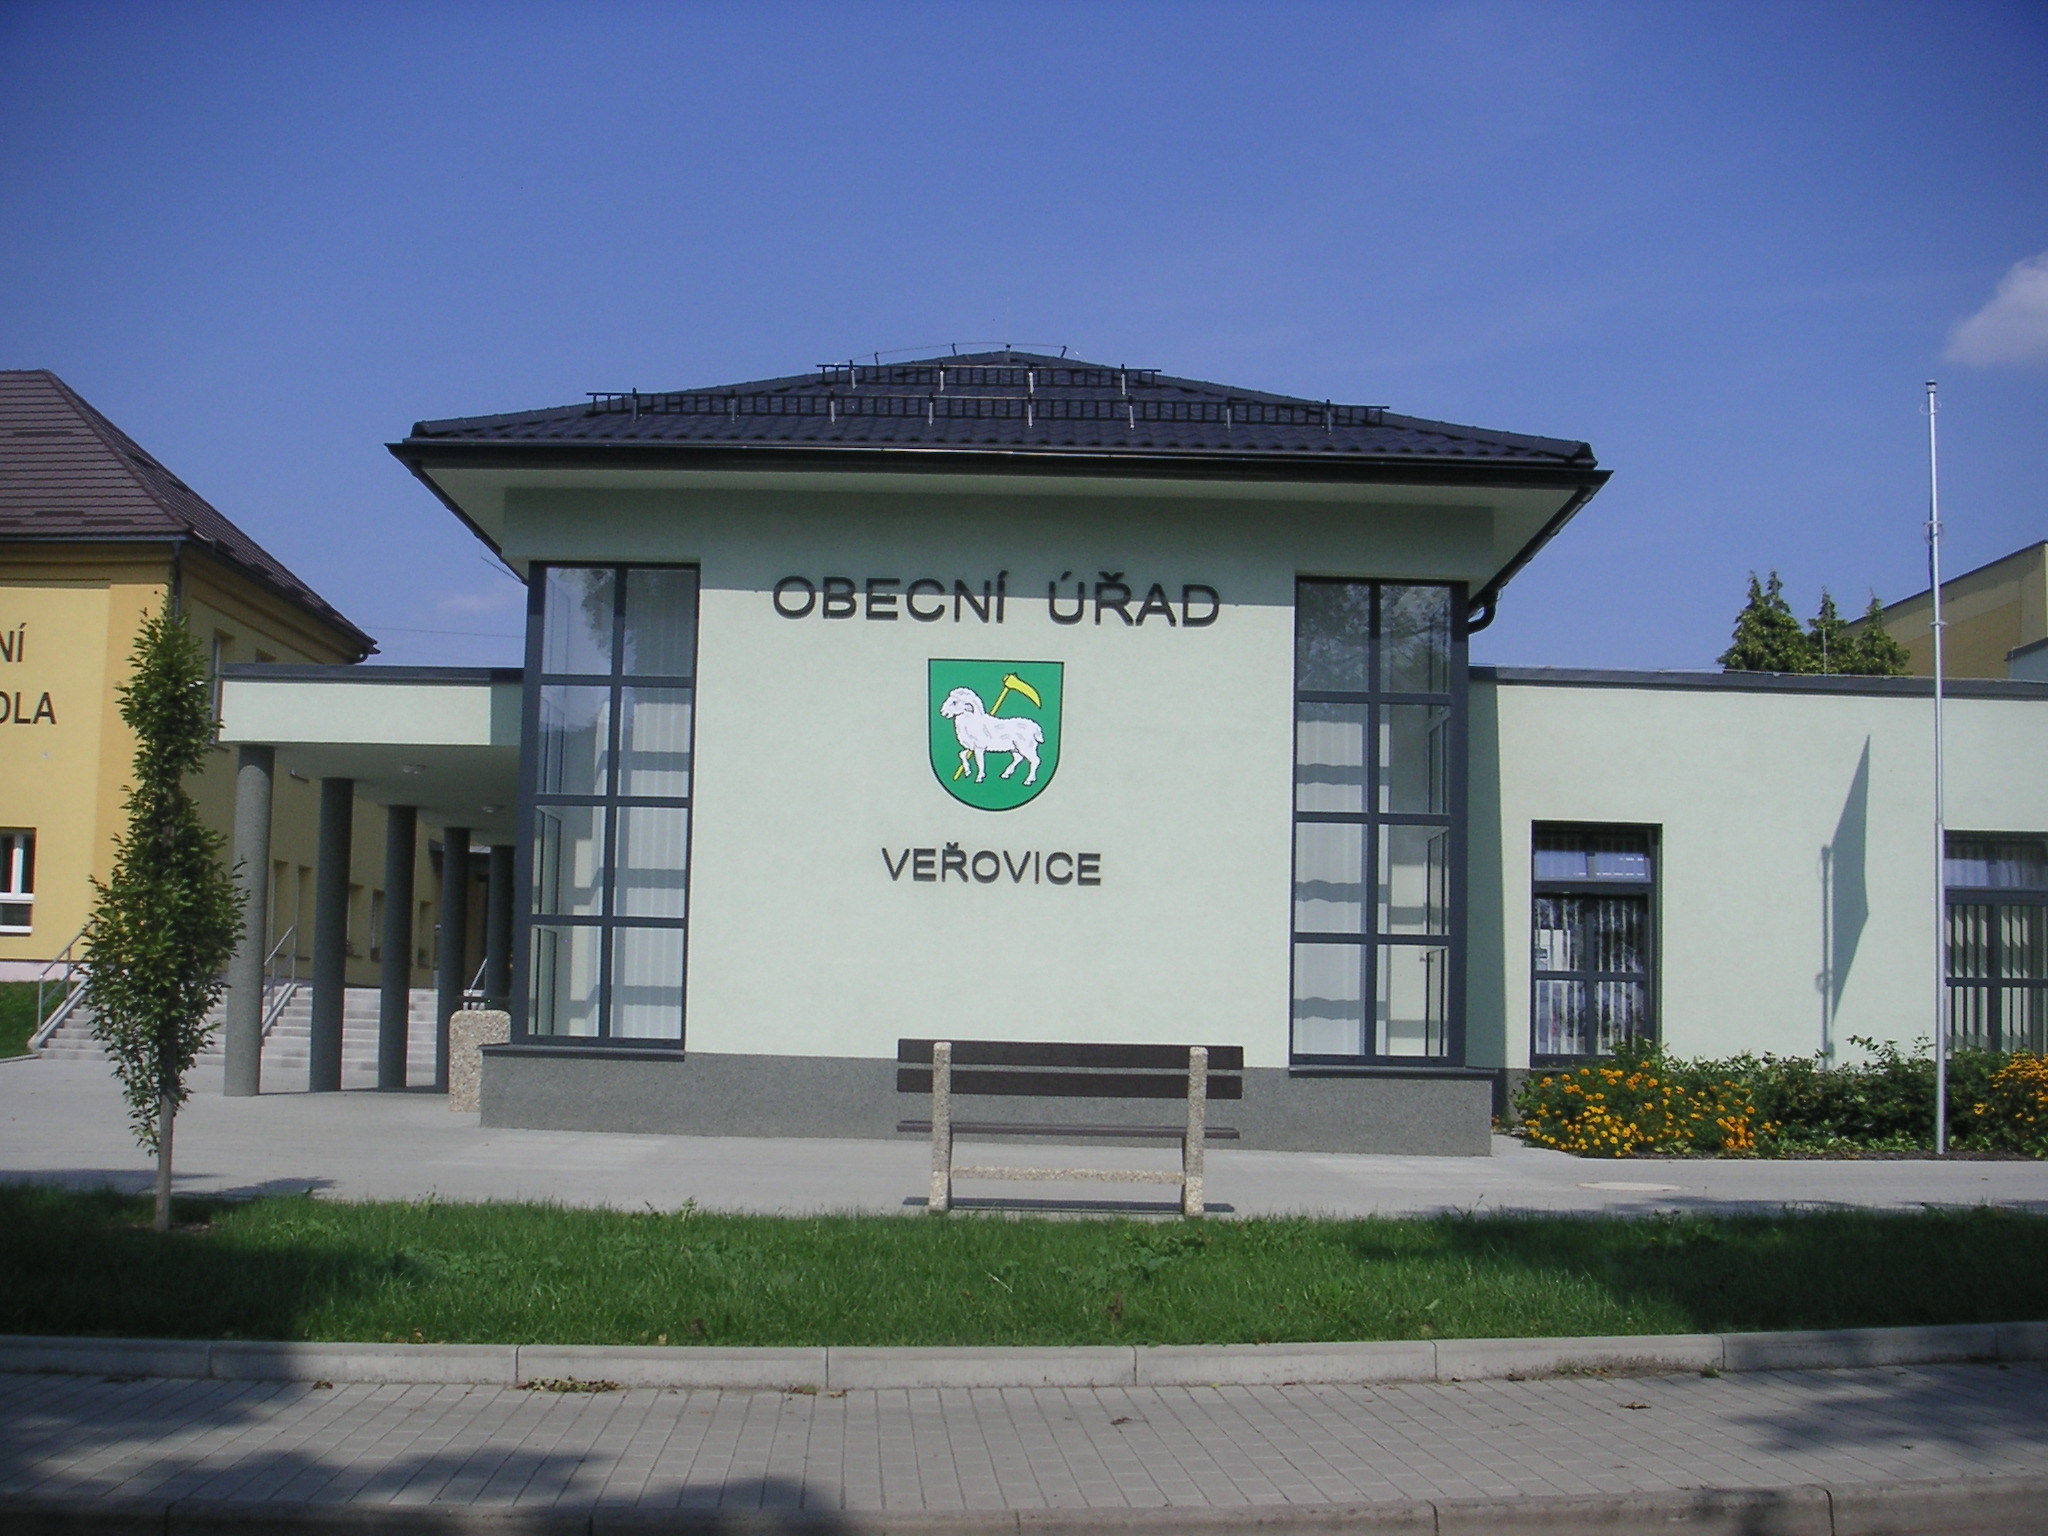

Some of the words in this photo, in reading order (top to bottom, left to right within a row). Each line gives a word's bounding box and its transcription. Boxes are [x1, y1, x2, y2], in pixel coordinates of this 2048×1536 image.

[772, 570, 1009, 624] OBECNÍ
[1048, 571, 1221, 628] ÚŘAD
[881, 842, 1102, 886] VEŘOVICE
